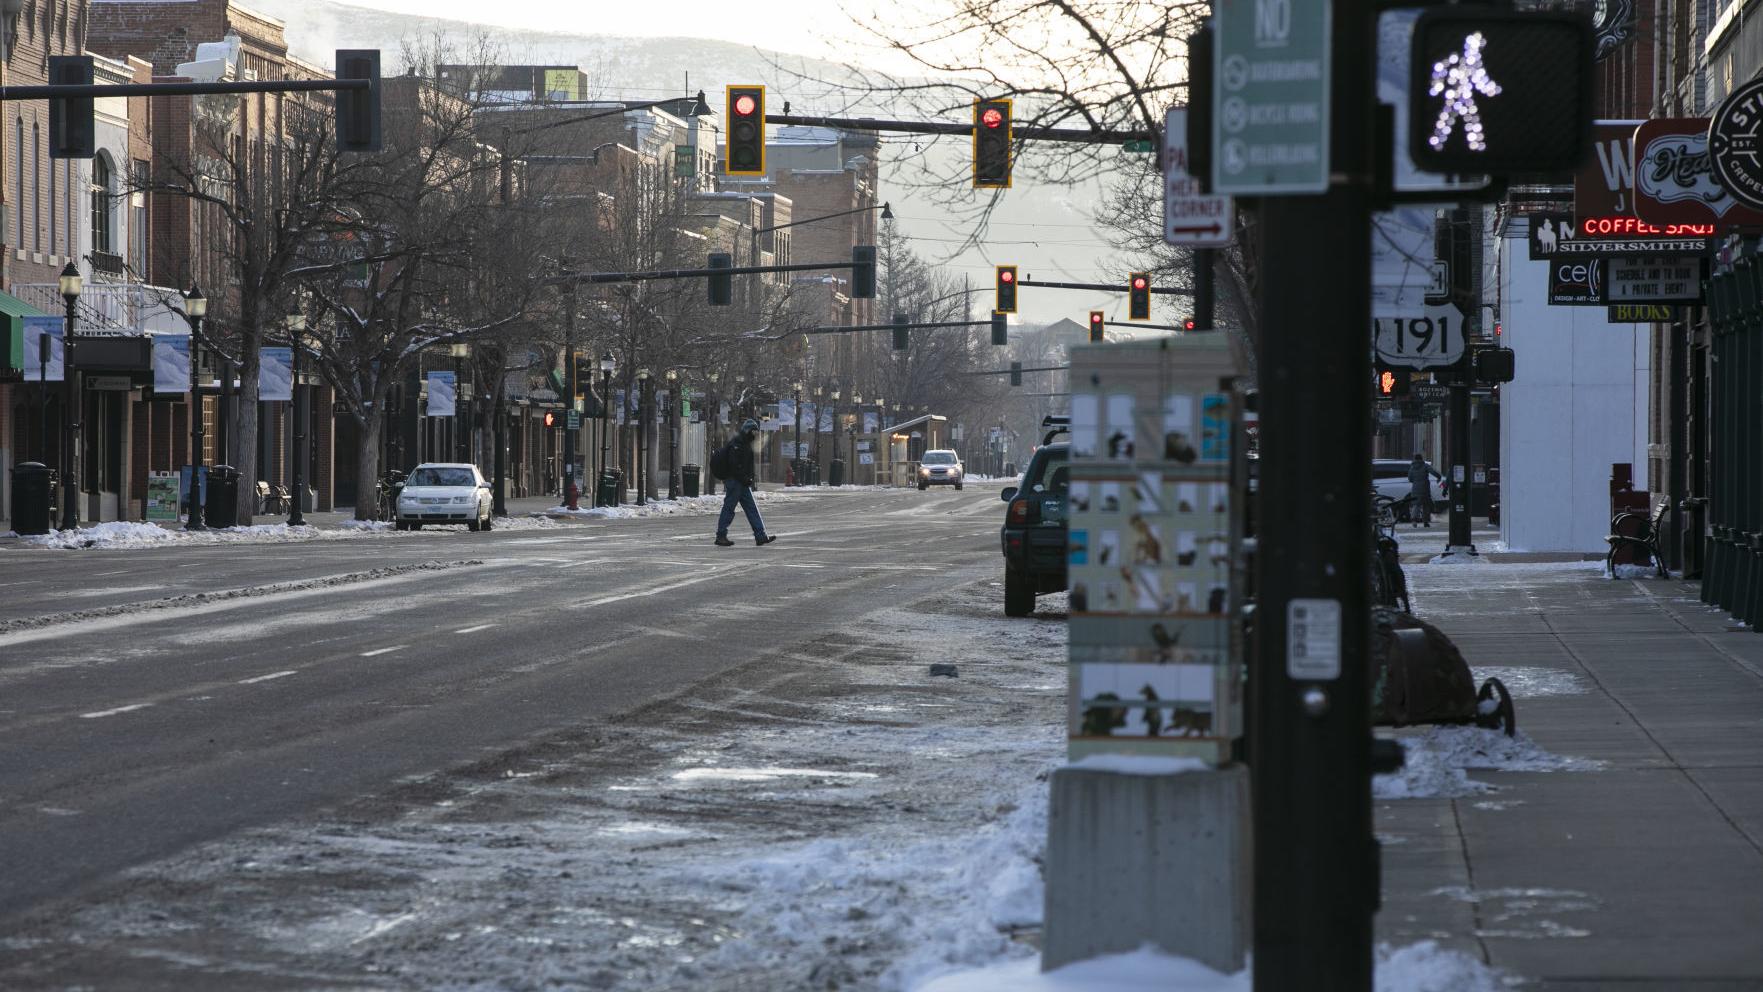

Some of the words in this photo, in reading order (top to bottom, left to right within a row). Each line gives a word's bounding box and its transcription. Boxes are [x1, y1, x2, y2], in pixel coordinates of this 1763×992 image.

[1256, 0, 1291, 39] NO
[1560, 241, 1706, 252] SILVERSMITHS
[1559, 259, 1600, 295] cell
[1617, 305, 1671, 320] BOOKS
[1394, 316, 1448, 353] 191
